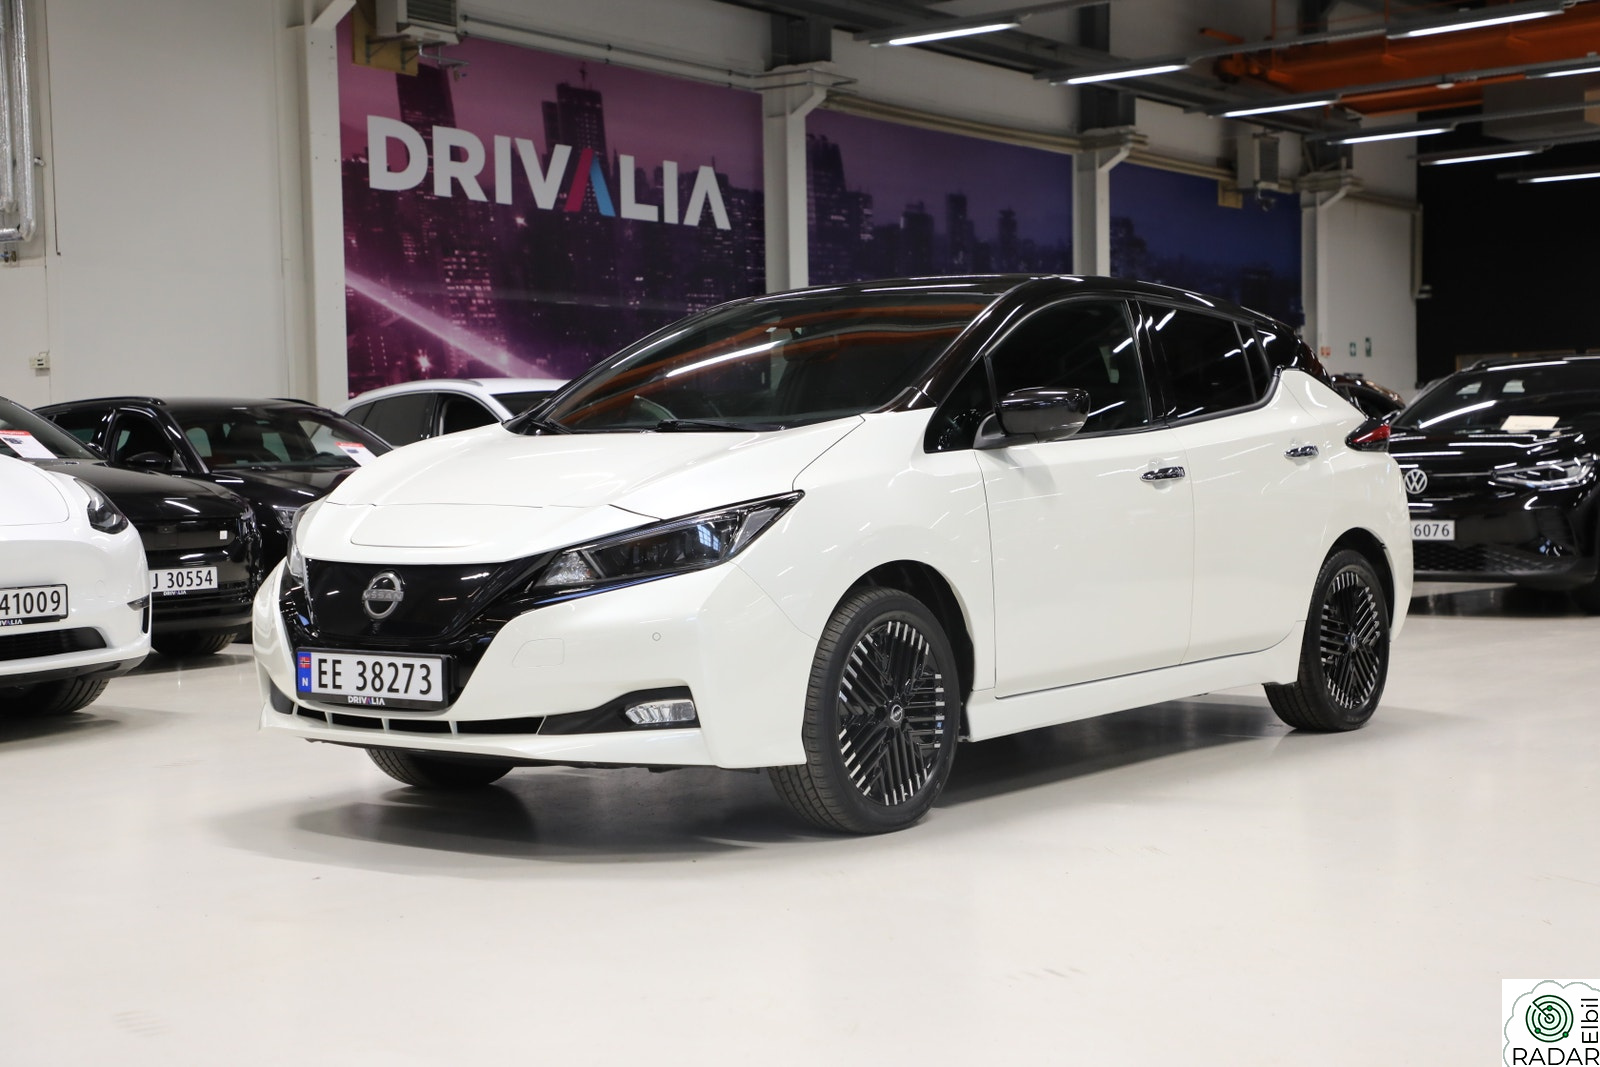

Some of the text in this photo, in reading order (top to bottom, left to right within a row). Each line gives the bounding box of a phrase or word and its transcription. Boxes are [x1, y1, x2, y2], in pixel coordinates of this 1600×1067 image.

[367, 115, 731, 231] DRIVALIA
[1413, 523, 1450, 537] 6076
[167, 570, 213, 589] 30554
[0, 590, 60, 615] 41009
[302, 677, 309, 687] N
[318, 659, 432, 695] EE 38273
[347, 696, 385, 705] DRIVALIA
